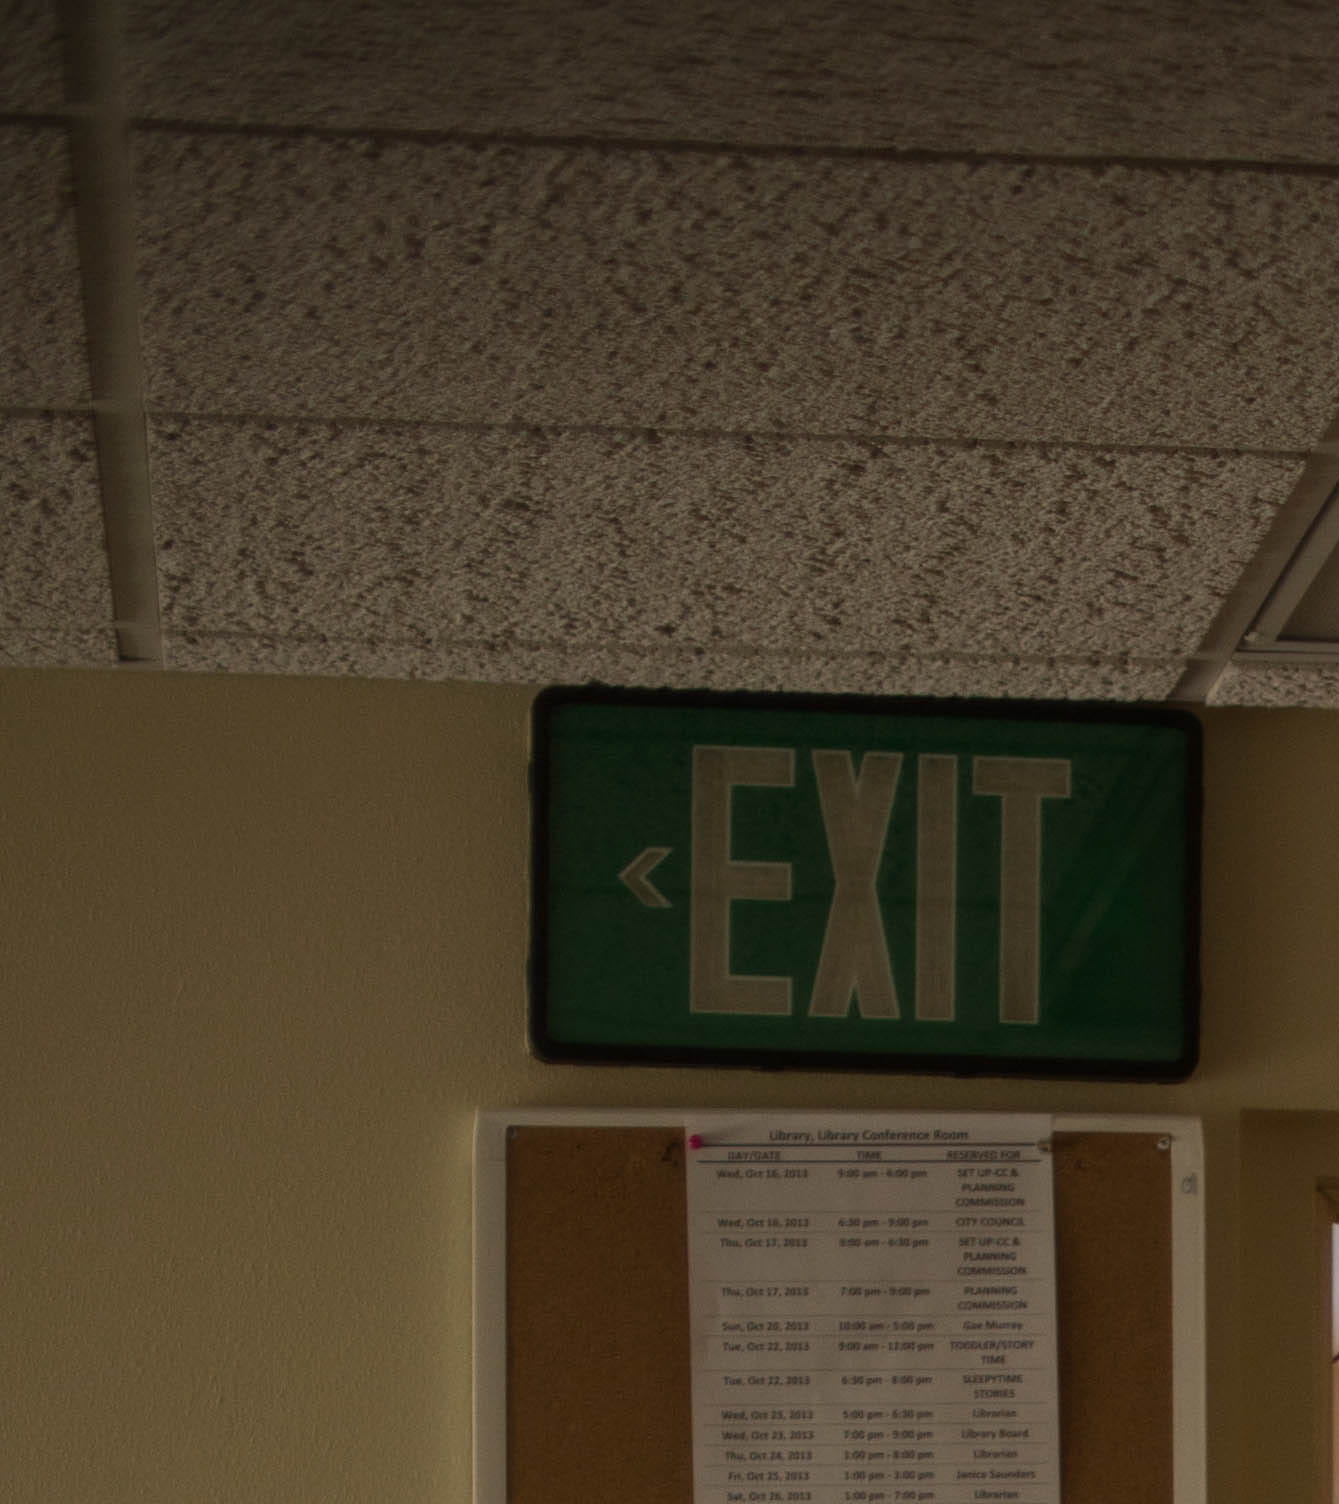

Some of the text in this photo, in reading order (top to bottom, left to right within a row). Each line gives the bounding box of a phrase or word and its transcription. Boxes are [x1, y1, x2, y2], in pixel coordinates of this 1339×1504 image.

[690, 745, 1072, 1024] EXIT
[768, 1128, 969, 1143] Library, Library Conference Room
